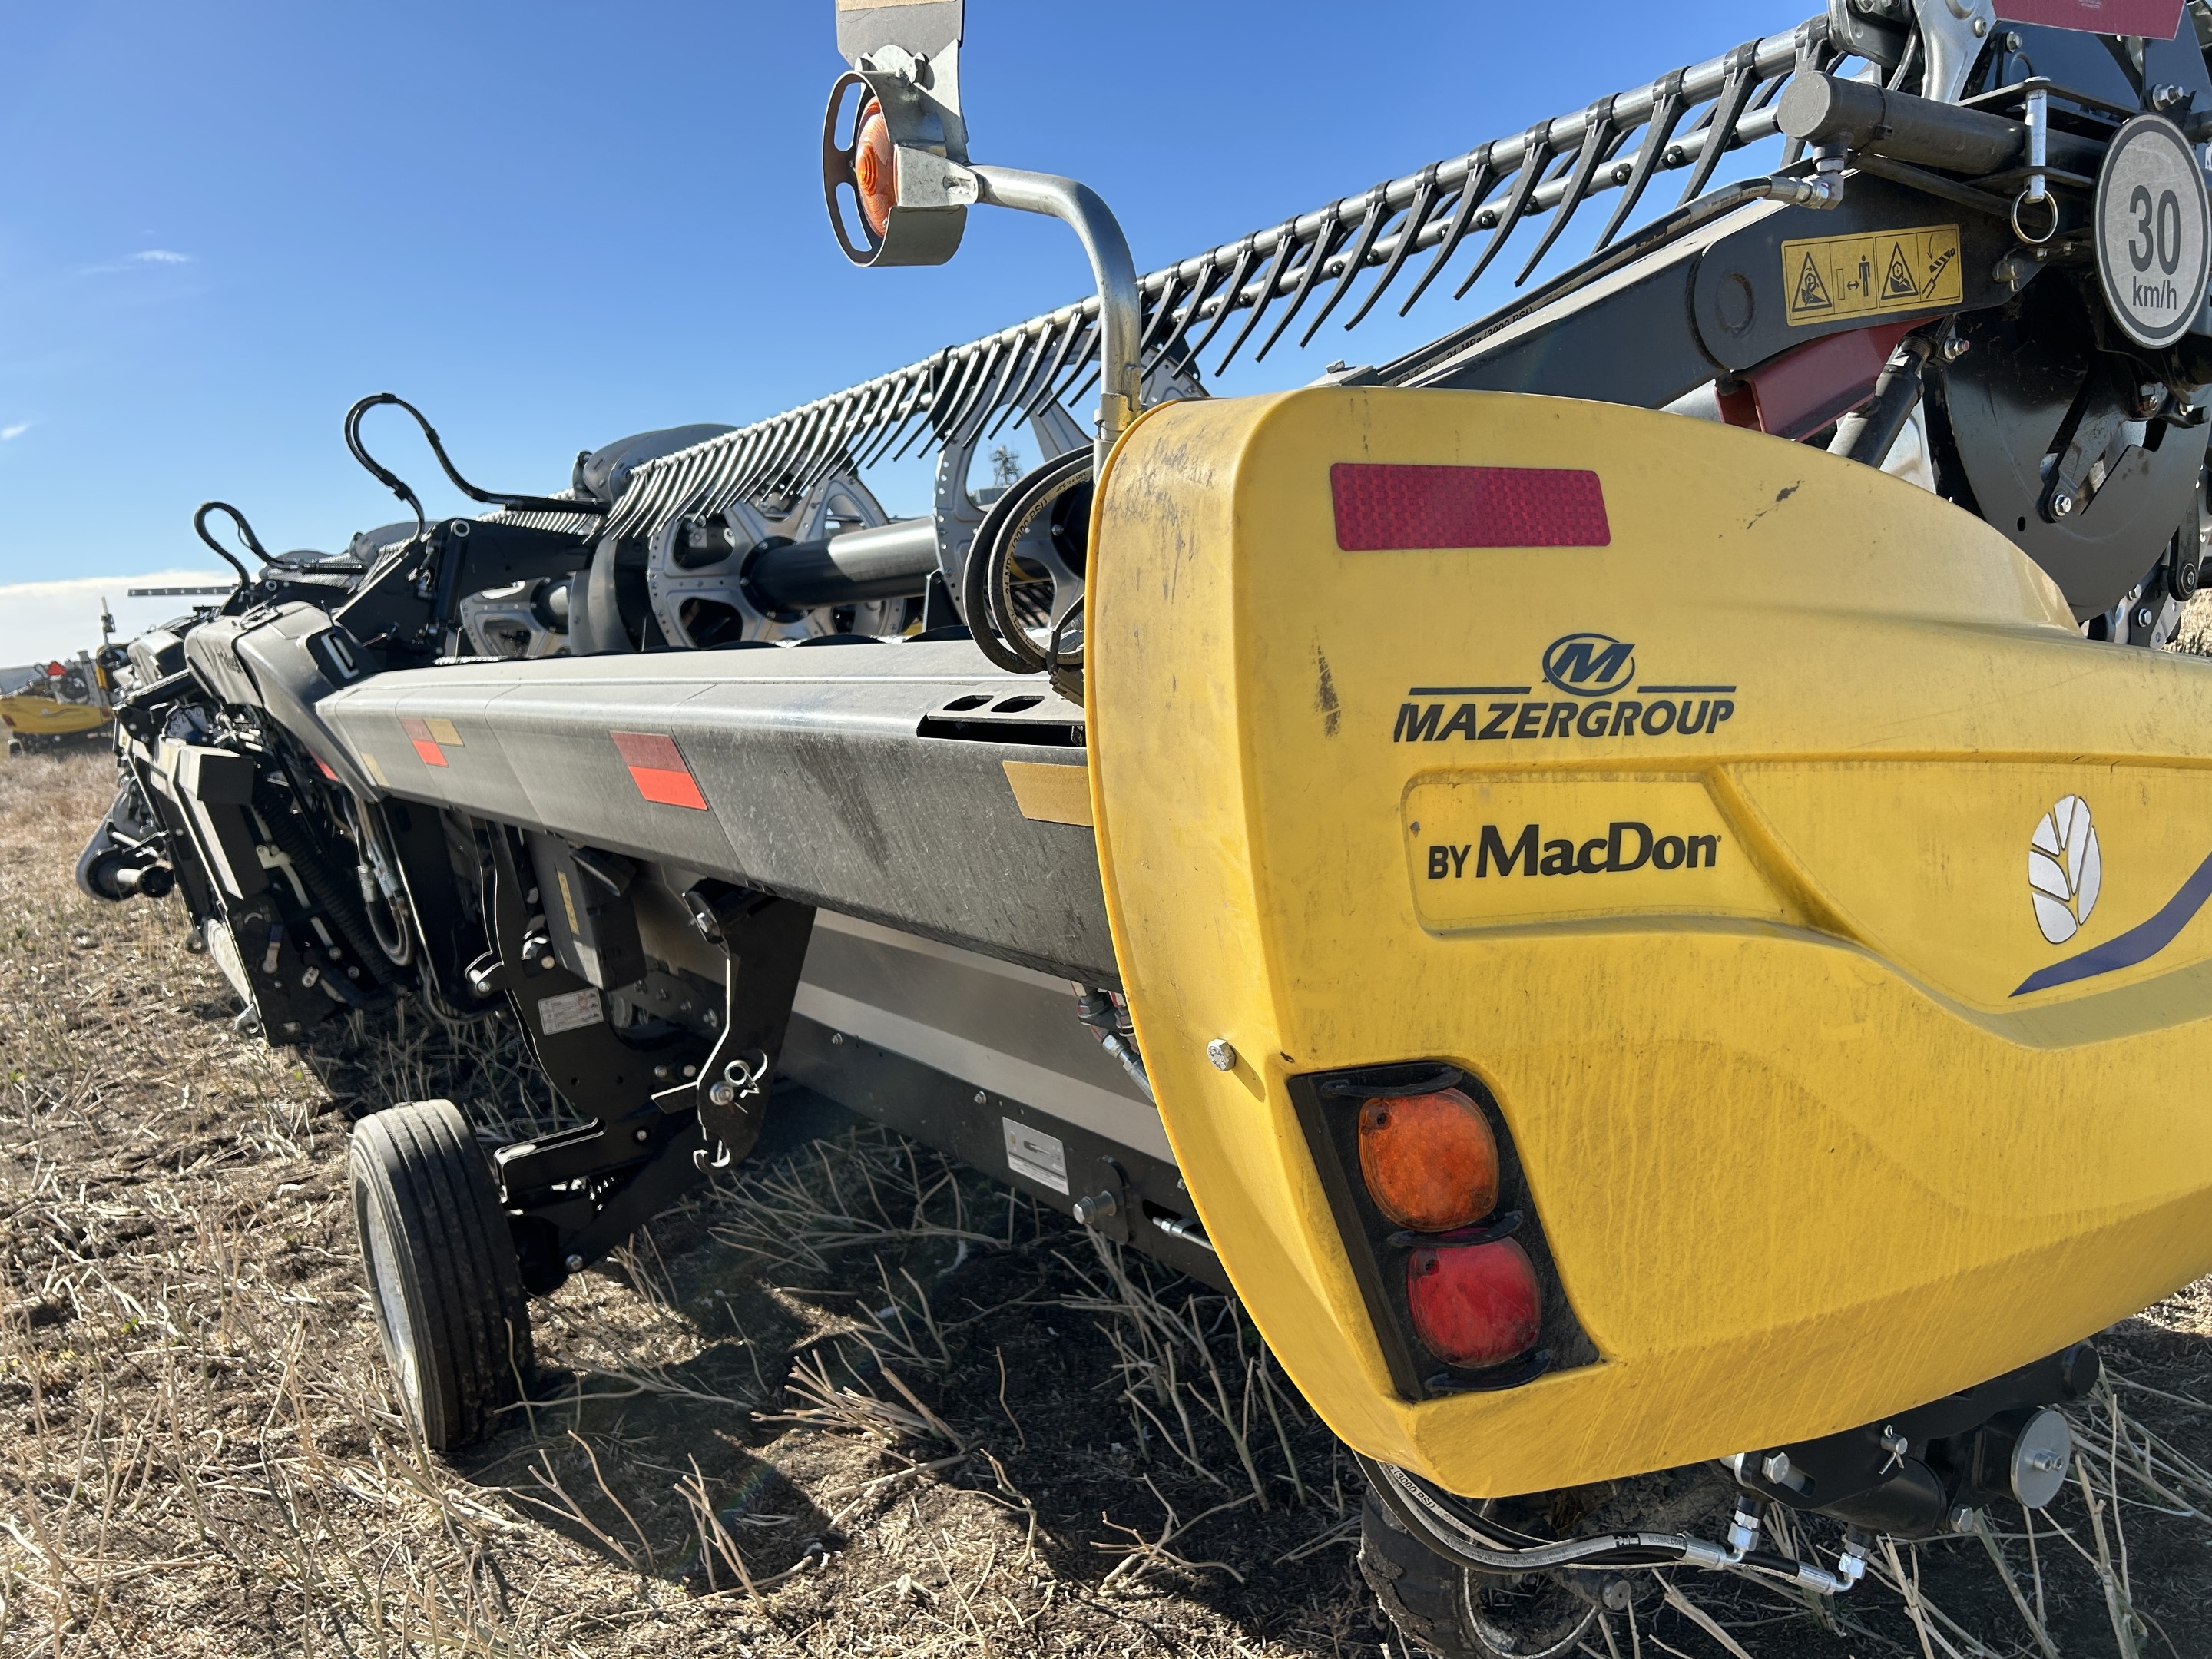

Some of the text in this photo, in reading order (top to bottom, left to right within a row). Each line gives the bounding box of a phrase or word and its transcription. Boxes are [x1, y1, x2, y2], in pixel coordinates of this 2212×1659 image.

[2128, 184, 2181, 276] 30
[2132, 276, 2177, 310] km/h
[1392, 700, 1735, 743] MAZERGROUP
[1427, 820, 1718, 879] BY MacDon
[1393, 1469, 1418, 1493] (3000
[1416, 1492, 1436, 1508] PSI)
